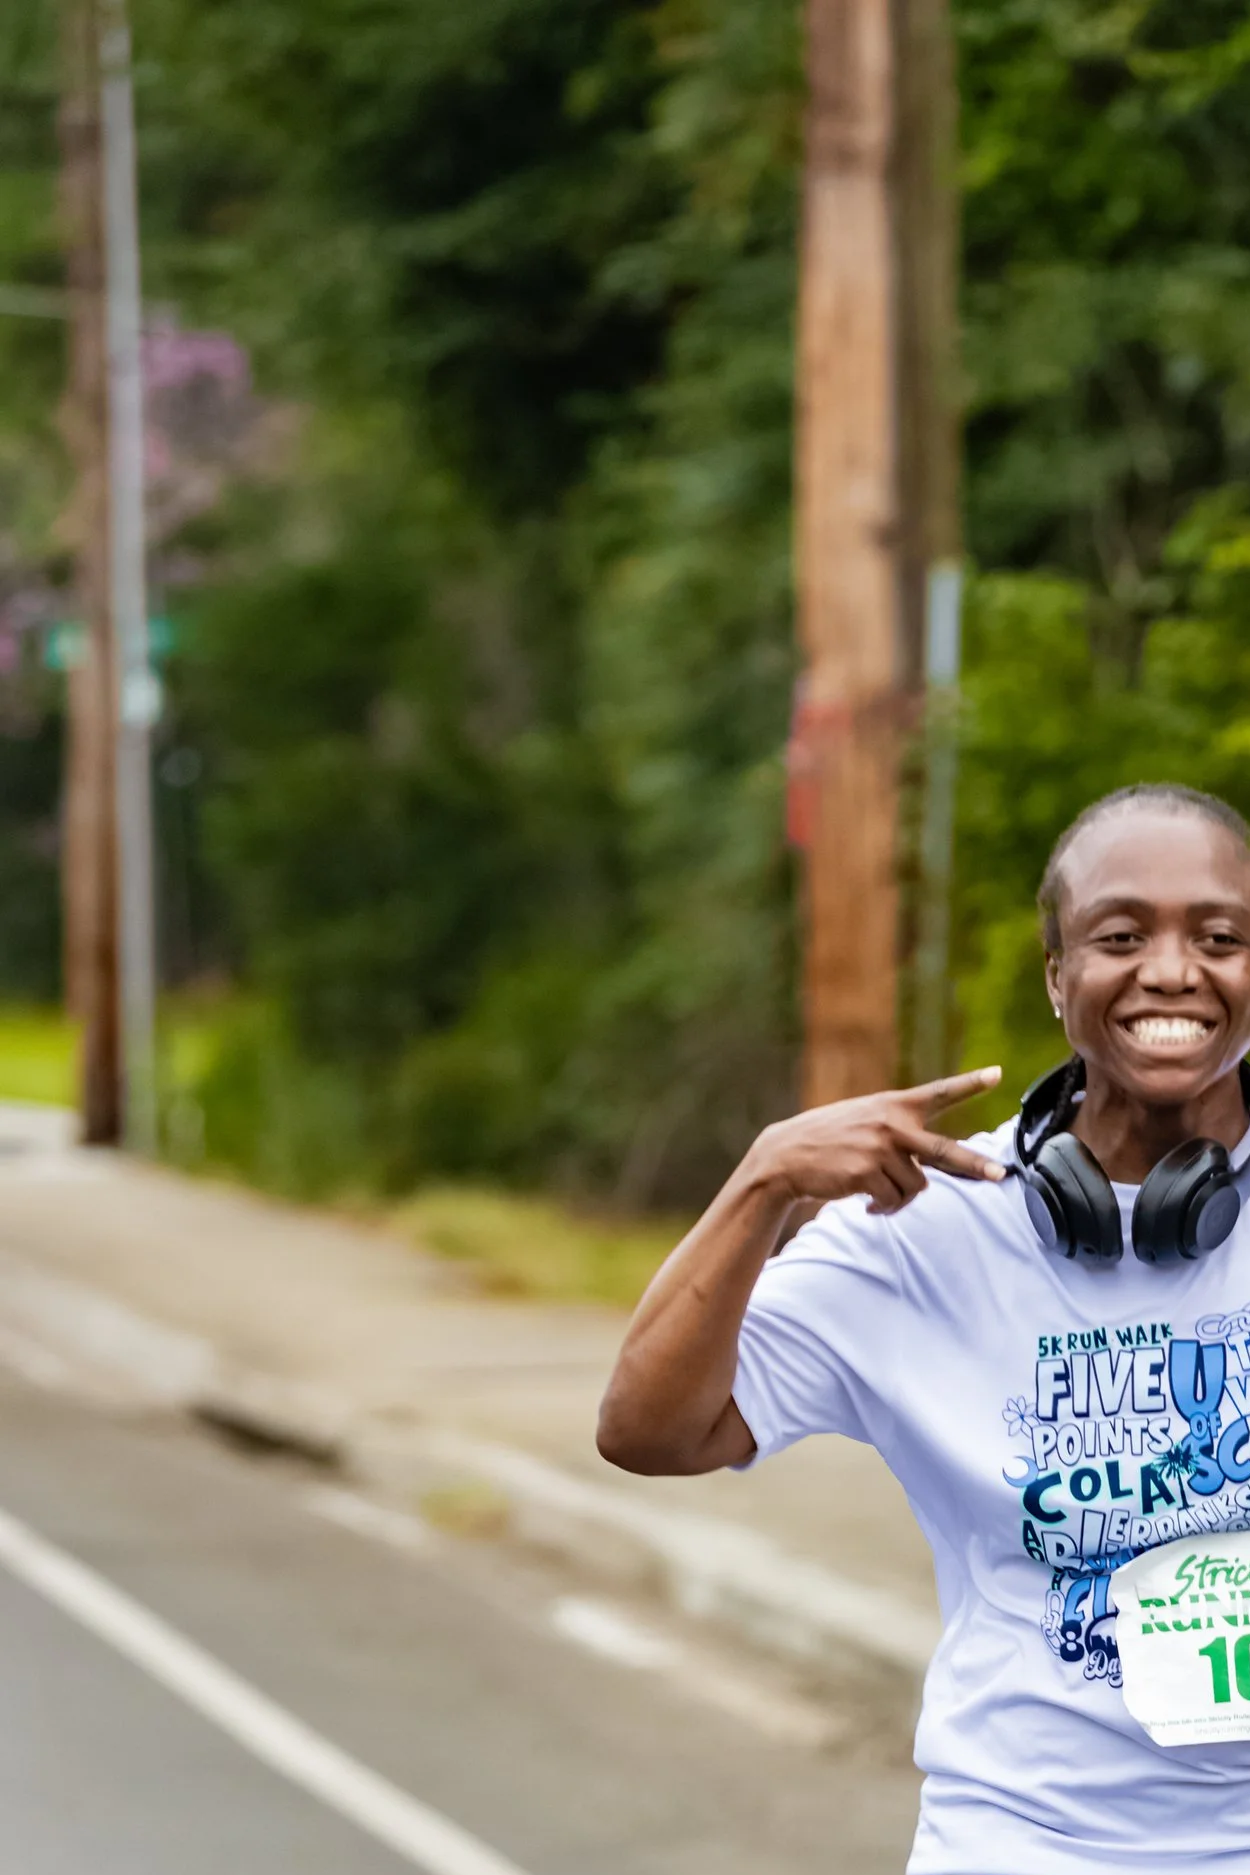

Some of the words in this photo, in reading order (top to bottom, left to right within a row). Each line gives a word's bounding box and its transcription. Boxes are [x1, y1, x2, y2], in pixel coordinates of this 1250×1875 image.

[1038, 1336, 1063, 1357] 5K
[1067, 1327, 1108, 1350] RUN
[1116, 1323, 1173, 1346] WALK
[1036, 1347, 1167, 1421] FIVE
[1168, 1339, 1227, 1423] U
[1031, 1416, 1174, 1471] POINTS
[1189, 1410, 1222, 1440] OF
[1022, 1459, 1176, 1524] COLA
